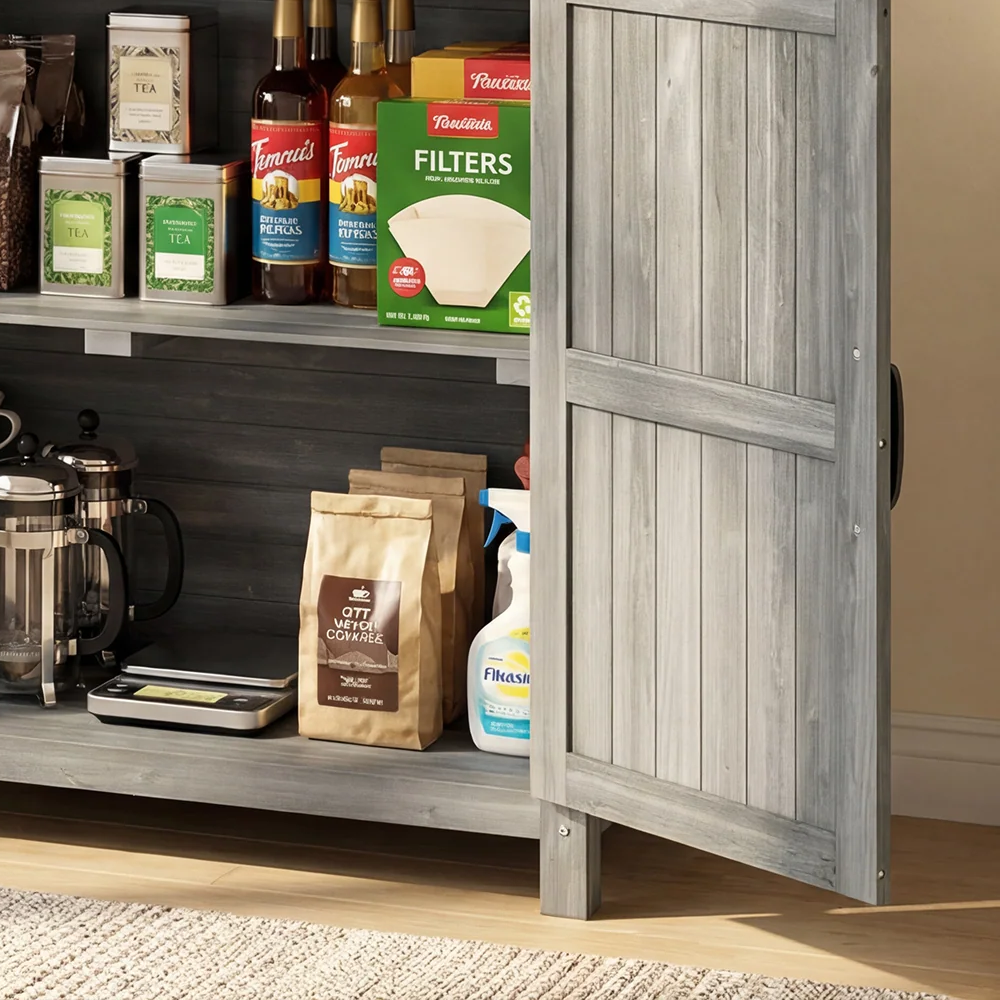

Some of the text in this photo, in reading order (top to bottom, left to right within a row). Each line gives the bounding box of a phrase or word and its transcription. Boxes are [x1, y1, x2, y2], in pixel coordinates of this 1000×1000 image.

[133, 82, 157, 94] TEA
[414, 149, 513, 175] FILTERS
[67, 227, 89, 239] TEA
[168, 233, 191, 245] TEA
